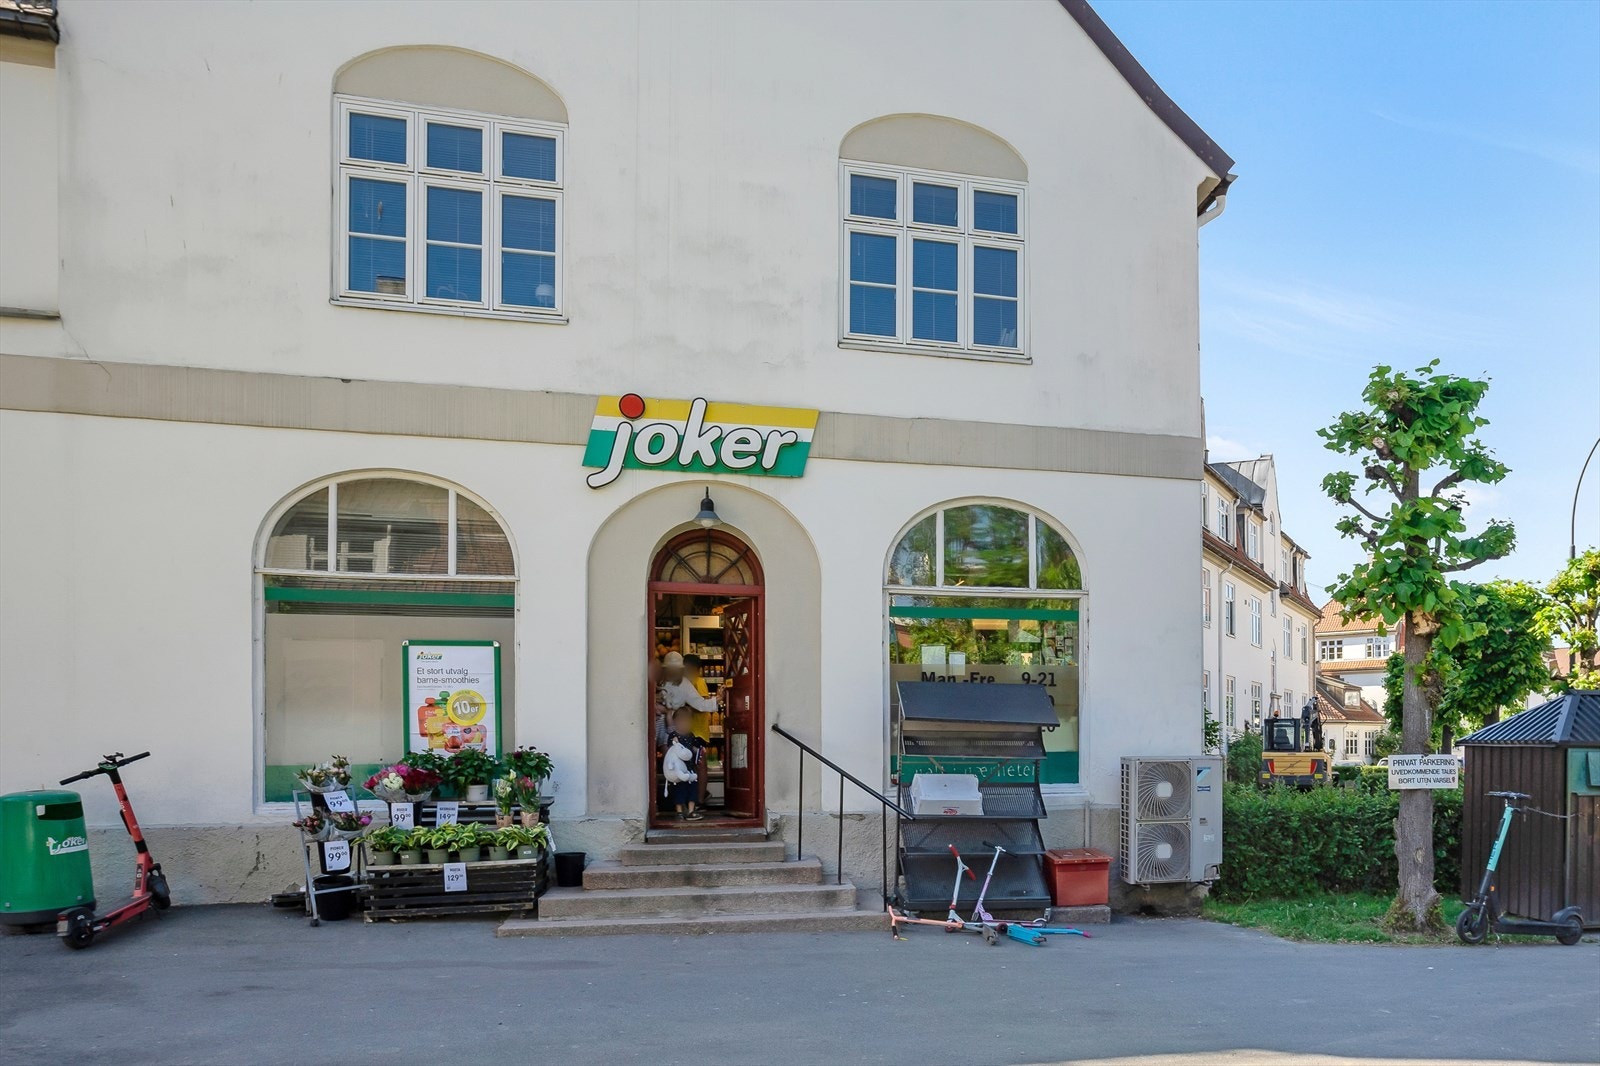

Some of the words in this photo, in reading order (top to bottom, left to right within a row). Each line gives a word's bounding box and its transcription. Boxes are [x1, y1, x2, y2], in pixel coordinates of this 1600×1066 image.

[586, 392, 798, 489] joker
[416, 667, 425, 675] Et
[426, 667, 444, 675] stort
[445, 667, 469, 677] utvalg
[416, 676, 480, 684] barne-smoothies
[1021, 671, 1057, 687] 9-21
[453, 700, 479, 715] 10er
[1393, 759, 1417, 767] PRIVAT
[1419, 758, 1455, 767] PARKERING
